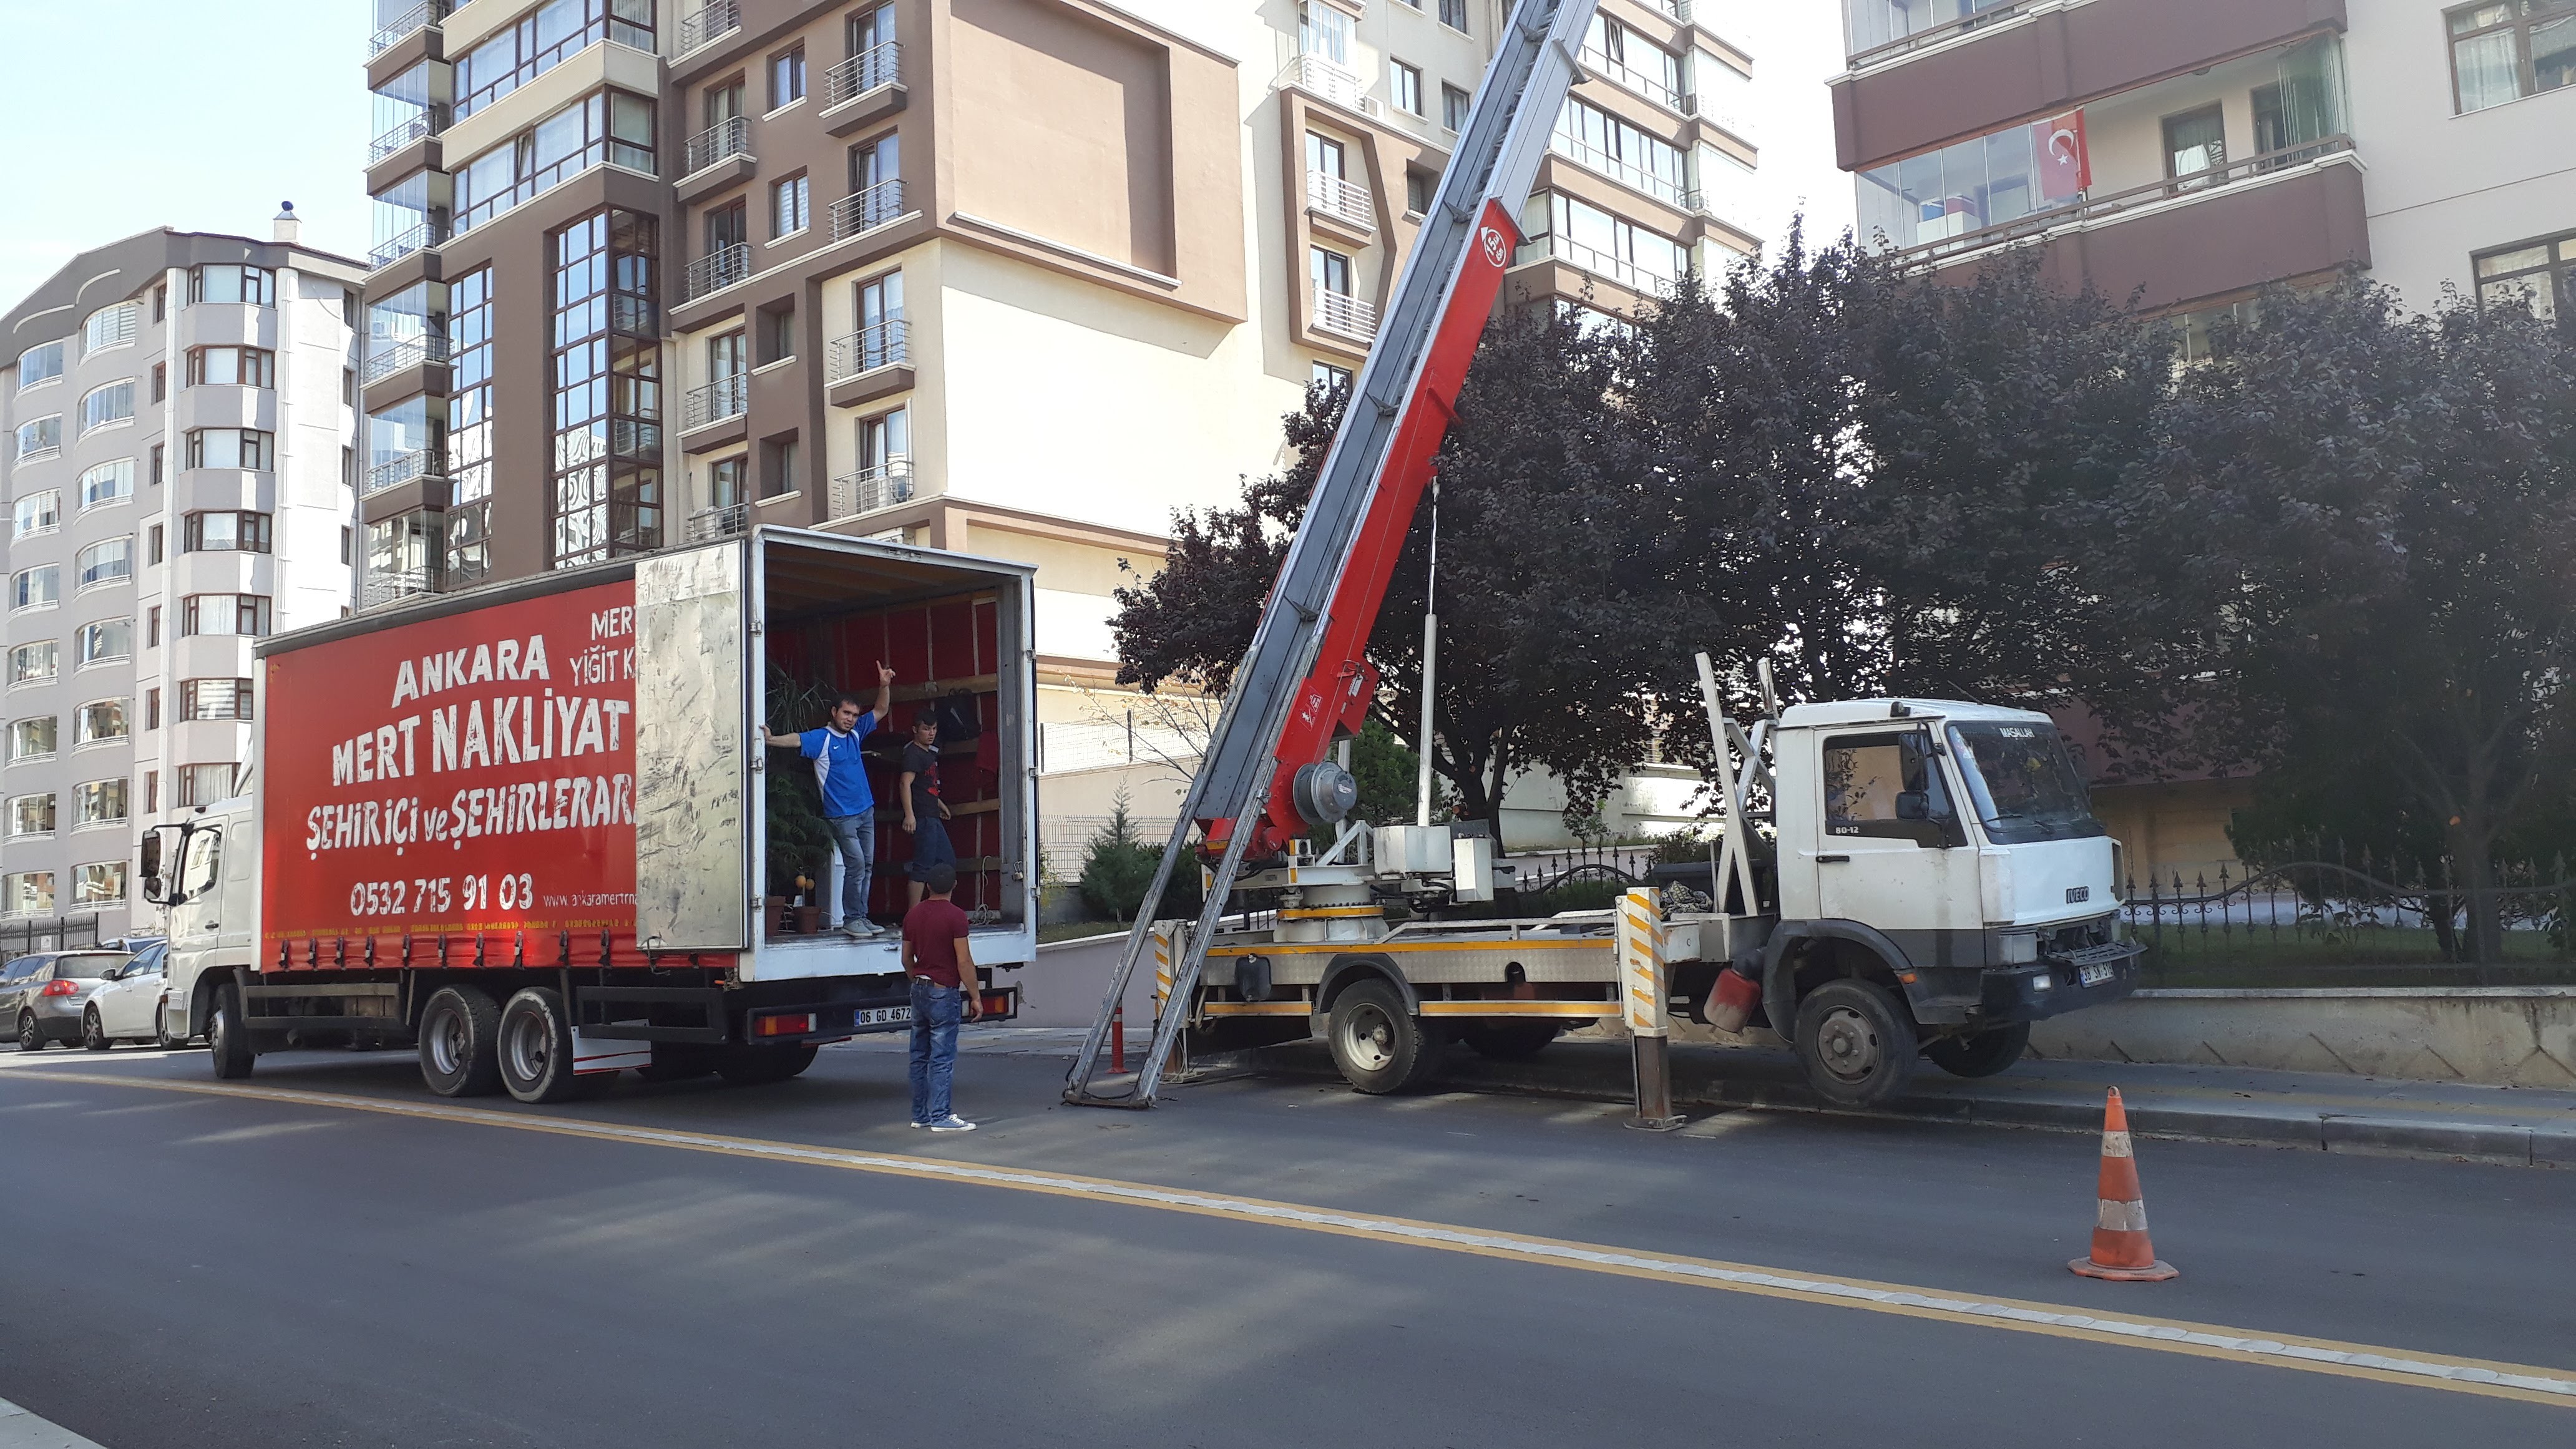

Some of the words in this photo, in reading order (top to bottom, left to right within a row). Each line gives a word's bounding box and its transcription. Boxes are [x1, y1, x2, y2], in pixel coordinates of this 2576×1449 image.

[591, 605, 636, 641] MER
[391, 634, 550, 709] ANKARA
[569, 644, 619, 687] YİĞİT
[333, 715, 421, 787] MERT
[432, 688, 630, 773] NAKLİYAT
[451, 773, 637, 851] ŞEHİRLERAR
[1835, 826, 1860, 834] 80-12
[351, 880, 406, 916] 0532
[413, 877, 451, 914] 715
[462, 874, 487, 910] 91
[499, 873, 534, 910] 03
[2067, 887, 2089, 903] IVECO
[861, 1012, 871, 1023] 06
[876, 1010, 887, 1022] GD
[890, 1007, 911, 1020] 4672
